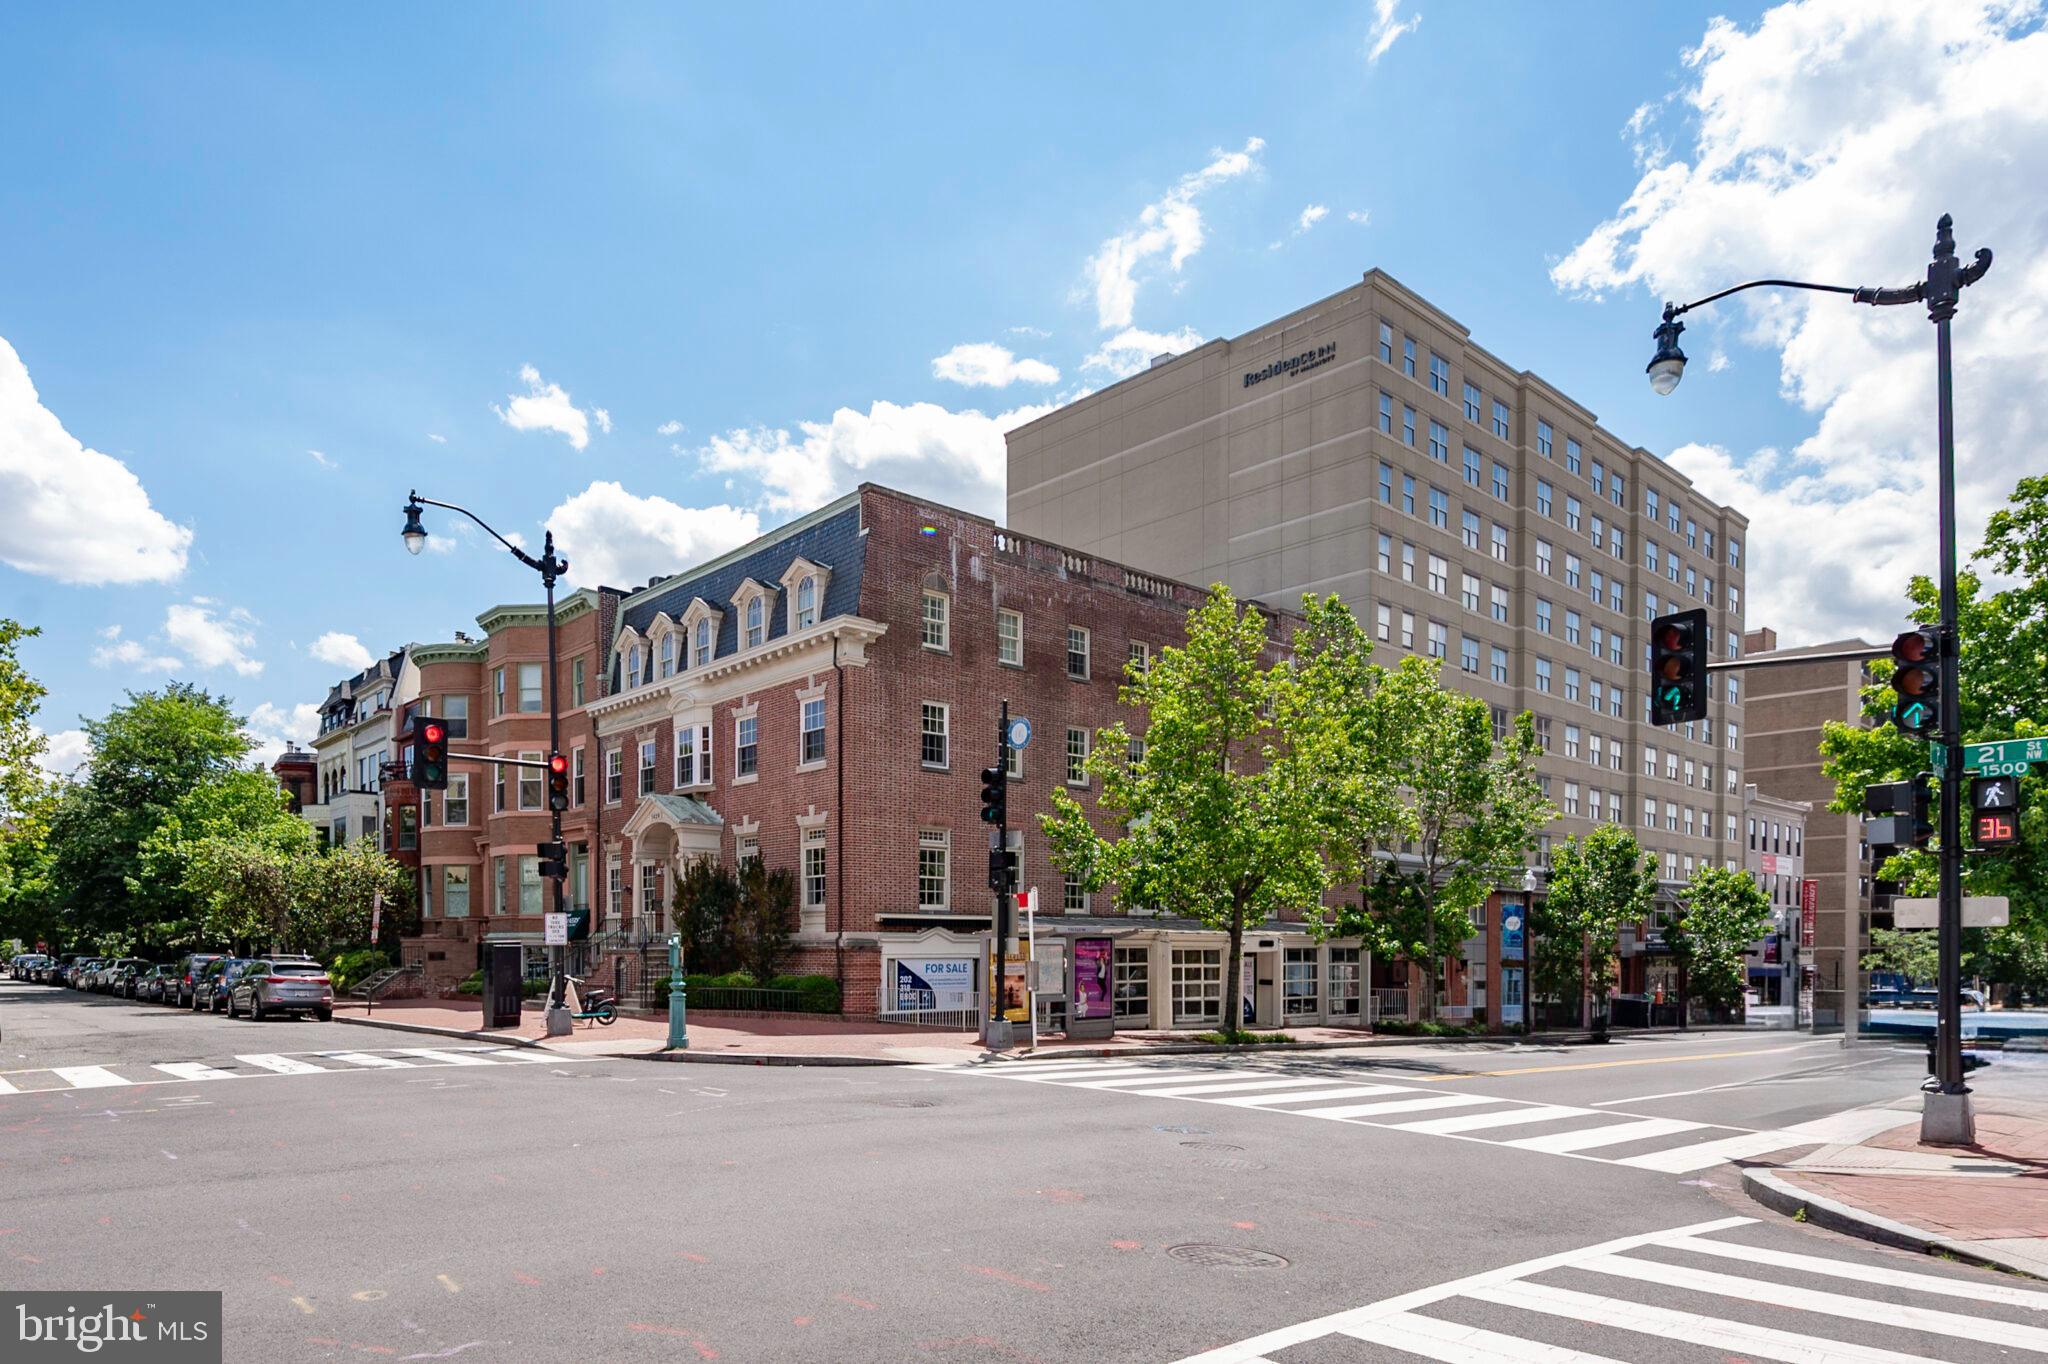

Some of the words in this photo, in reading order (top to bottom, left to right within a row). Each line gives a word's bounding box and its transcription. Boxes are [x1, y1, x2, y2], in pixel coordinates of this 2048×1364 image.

[1243, 349, 1316, 388] Residence
[1978, 745, 2004, 763] 21
[2026, 741, 2042, 751] St
[2026, 749, 2042, 760] NW
[1982, 761, 2028, 777] 1500
[1979, 818, 2012, 840] 36
[925, 963, 944, 974] FOR
[945, 963, 968, 974] SALE
[899, 975, 912, 984] 202
